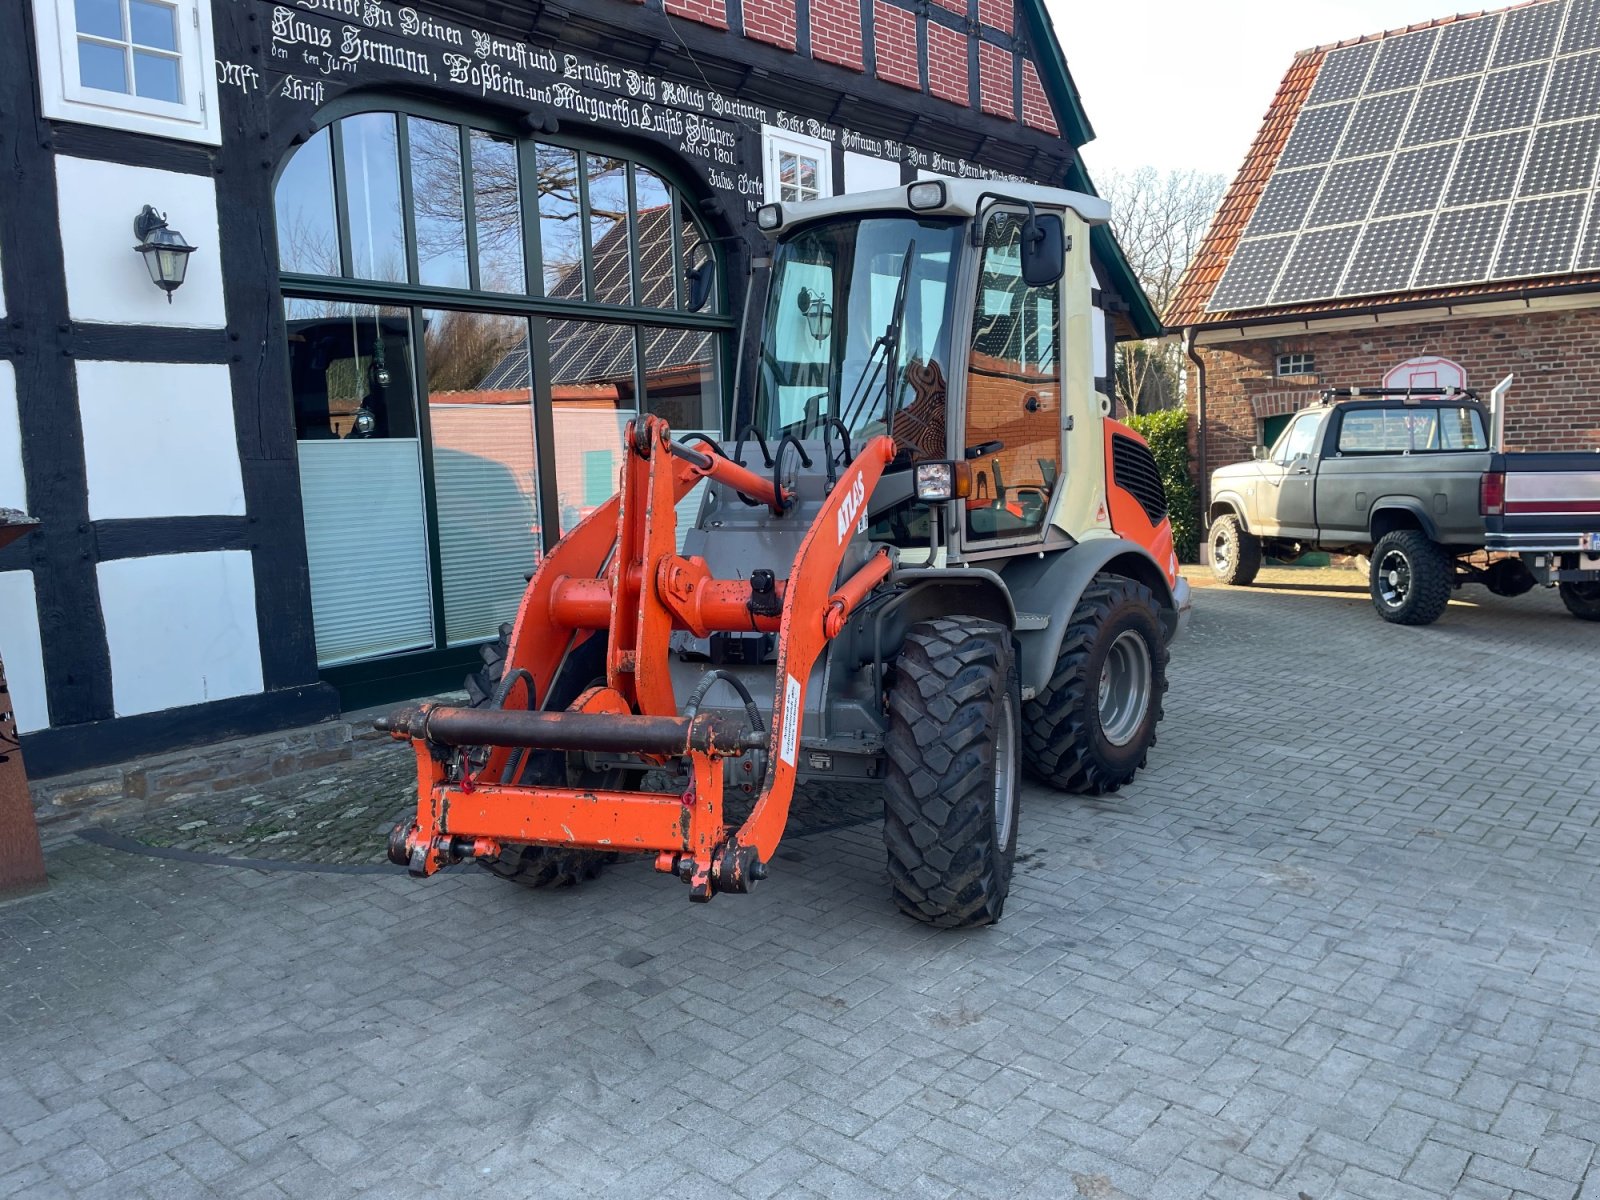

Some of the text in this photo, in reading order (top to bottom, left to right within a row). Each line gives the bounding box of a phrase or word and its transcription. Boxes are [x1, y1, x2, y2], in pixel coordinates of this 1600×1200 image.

[271, 42, 288, 59] den
[320, 52, 359, 74] Juni
[398, 6, 463, 46] Deinen
[529, 48, 557, 73] und
[563, 54, 621, 89] Ernähre
[623, 68, 656, 101] Dich
[661, 81, 705, 112] Redlich
[806, 118, 836, 141] Deine
[841, 128, 882, 157] Hoffnung
[679, 142, 710, 158] ANNO
[837, 470, 865, 546] ATLAS
